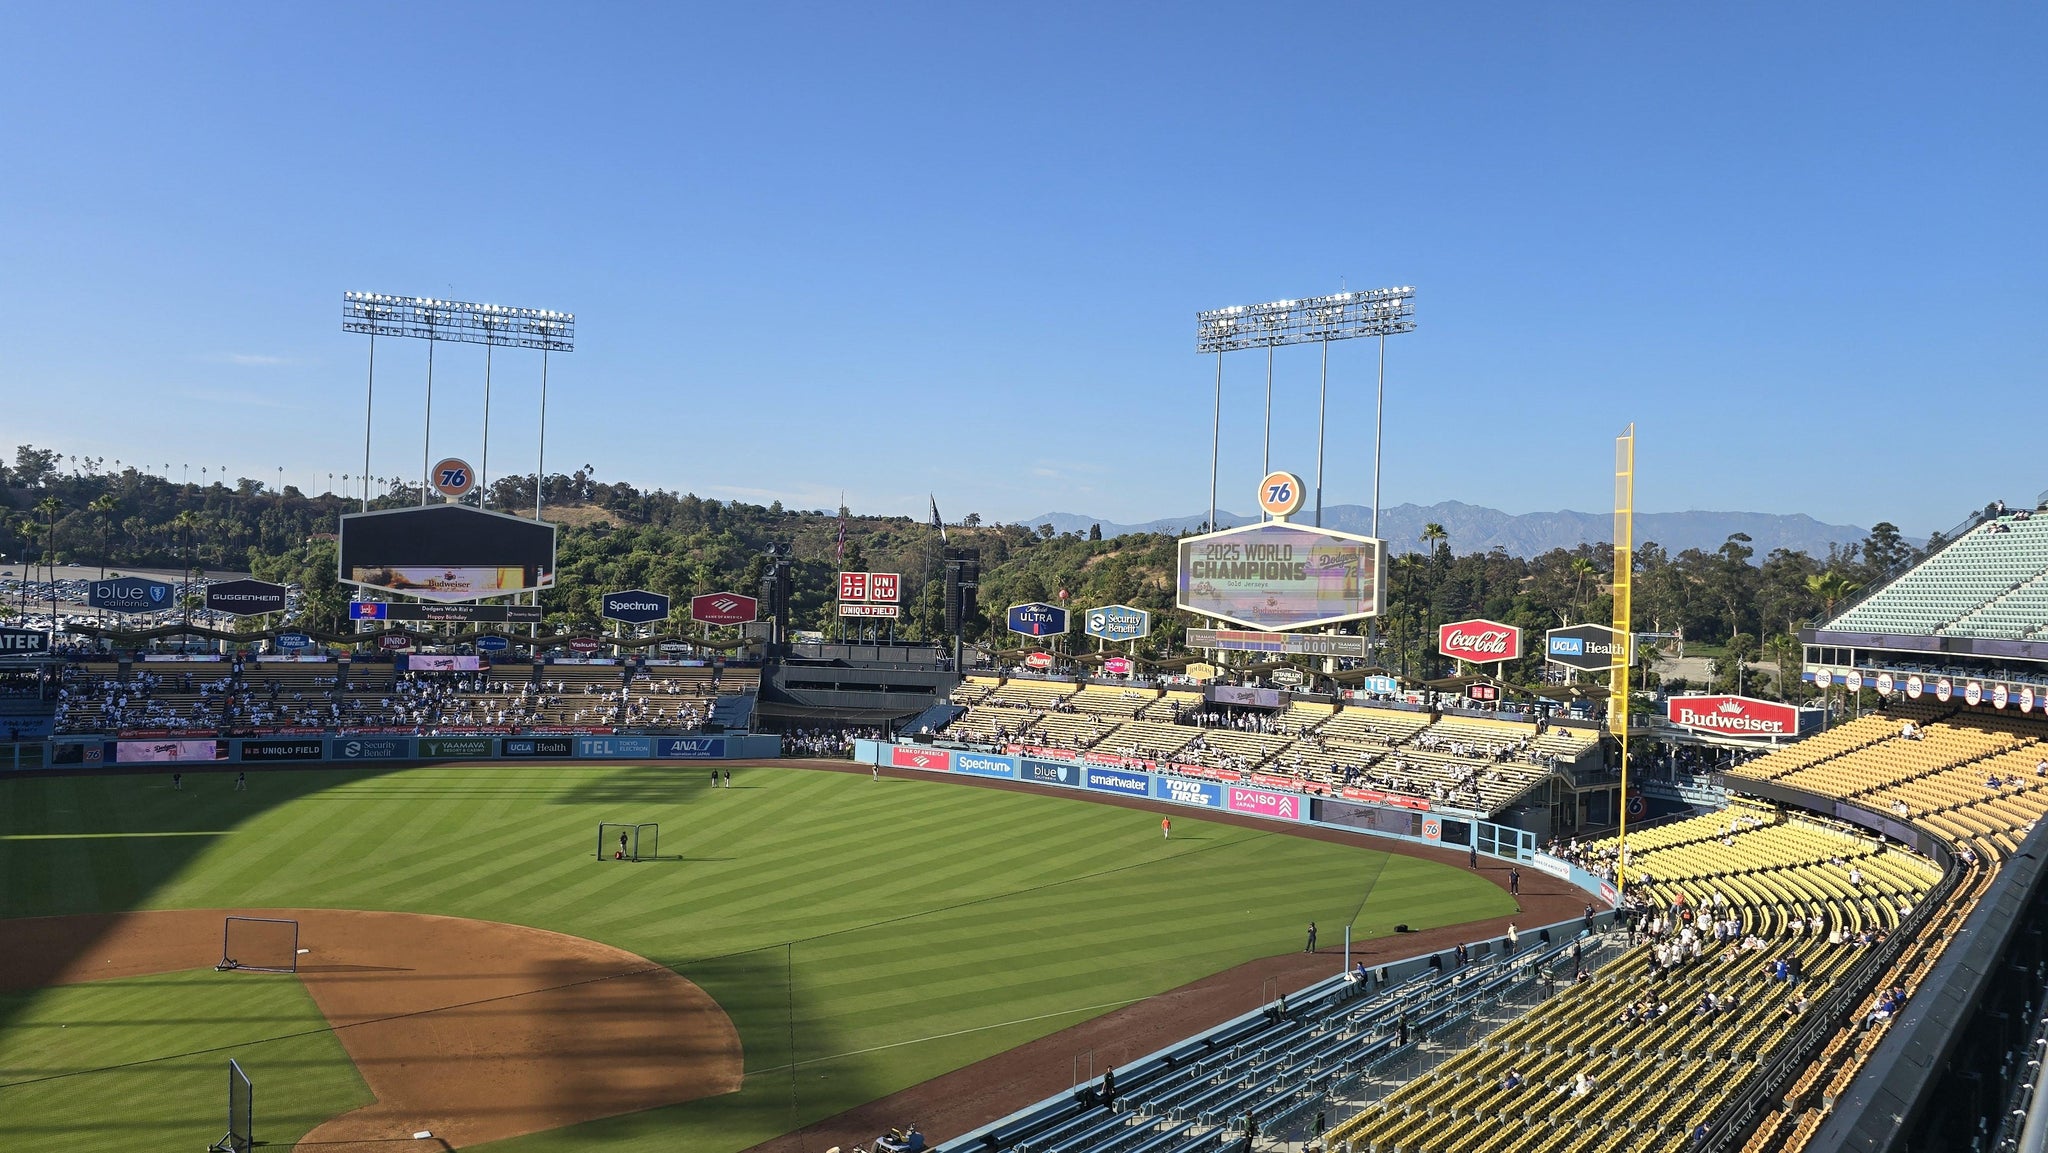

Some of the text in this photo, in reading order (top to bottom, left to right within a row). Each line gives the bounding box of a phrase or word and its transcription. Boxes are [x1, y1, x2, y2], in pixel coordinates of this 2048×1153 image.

[440, 468, 467, 487] 76
[1267, 482, 1292, 503] 76
[1207, 544, 1292, 561] 2025 WORLD
[1192, 561, 1307, 580] CHAMPIONS
[428, 579, 470, 588] Budweiser
[875, 577, 893, 587] UNI
[97, 583, 144, 599] blue
[875, 588, 894, 598] QLO
[610, 601, 658, 611] Spectrum
[843, 607, 870, 615] UNIQLO
[1021, 613, 1053, 622] ULTRA
[1109, 614, 1141, 626] Security
[1109, 623, 1136, 633] Benefit
[384, 637, 406, 646] JINRO
[1446, 629, 1510, 653] Coca-Cola
[1552, 641, 1579, 651] UCLA
[1585, 642, 1624, 655] Health
[1369, 678, 1393, 691] TEL
[262, 747, 293, 755] UNIQLO
[364, 741, 396, 751] Security
[537, 743, 566, 752] Health
[582, 741, 613, 754] TEL
[671, 741, 697, 751] ANA
[86, 750, 101, 760] 76
[364, 749, 391, 757] Benefit
[960, 757, 1007, 772] Spectrum
[1034, 764, 1057, 777] blue
[1090, 775, 1145, 791] smartwater
[1166, 780, 1201, 793] TOYO
[1171, 790, 1209, 805] TIRES
[1235, 791, 1276, 805] DAISO
[1425, 825, 1439, 834] 76
